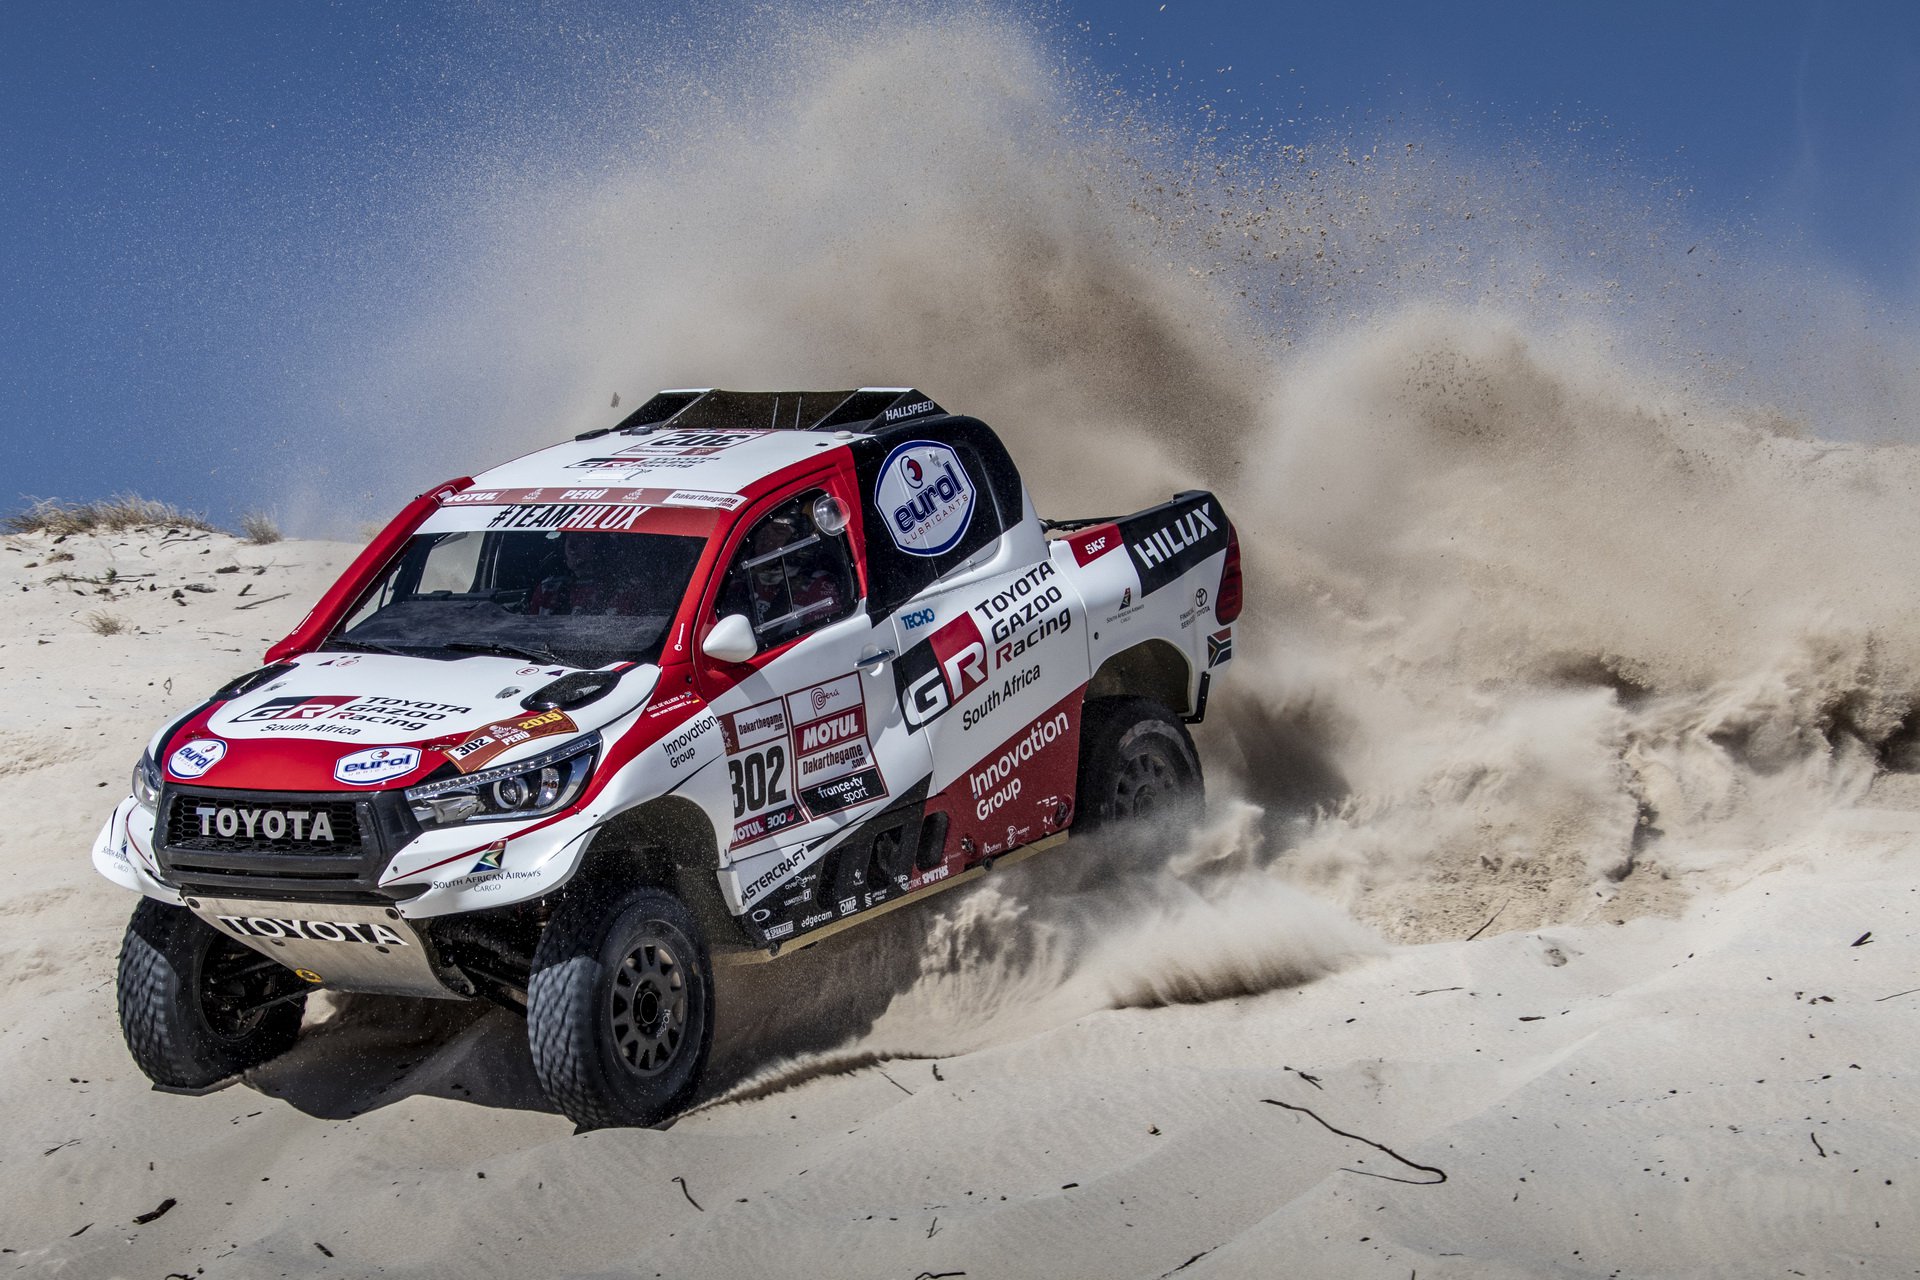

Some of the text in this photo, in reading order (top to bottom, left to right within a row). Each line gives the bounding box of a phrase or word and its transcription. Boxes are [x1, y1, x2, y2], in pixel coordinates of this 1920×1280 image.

[886, 401, 934, 421] HALLSPEED
[893, 460, 964, 534] eurol
[486, 504, 651, 530] #TEAMHILUX
[905, 494, 969, 545] LUBRICANTS
[1085, 537, 1106, 555] SKF
[1133, 502, 1218, 569] HILUX
[975, 561, 1055, 620] TOYOTA
[901, 608, 935, 630] TECHO
[991, 586, 1062, 644] GAZOO
[996, 608, 1071, 670] Racing
[903, 641, 986, 726] GR
[367, 696, 472, 714] TOYOTA
[963, 665, 1041, 731] South Africa
[235, 703, 336, 723] GR
[327, 711, 428, 731] Racing
[344, 704, 446, 721] GAZOO
[518, 712, 564, 730] 2019
[738, 713, 783, 735] Dakarthegame
[260, 723, 362, 736] South Africa
[662, 715, 718, 756] Innovation
[803, 713, 858, 750] MOTUL
[180, 747, 214, 769] eurol
[454, 738, 490, 757] 302
[670, 747, 696, 768] Group
[803, 744, 864, 775] Dakarthegame
[970, 712, 1069, 799] Innovation
[343, 753, 412, 774] eurol
[728, 745, 787, 819] 302
[843, 786, 868, 804] sport
[976, 778, 1021, 820] Group
[196, 806, 335, 841] TOYOTA
[433, 869, 542, 889] SOUTH AFRICAN AIRWAYS
[742, 844, 809, 906] ASTERCRAFT
[473, 883, 502, 893] CARGO
[840, 899, 857, 913] OMP
[216, 915, 410, 946] TOYOTA
